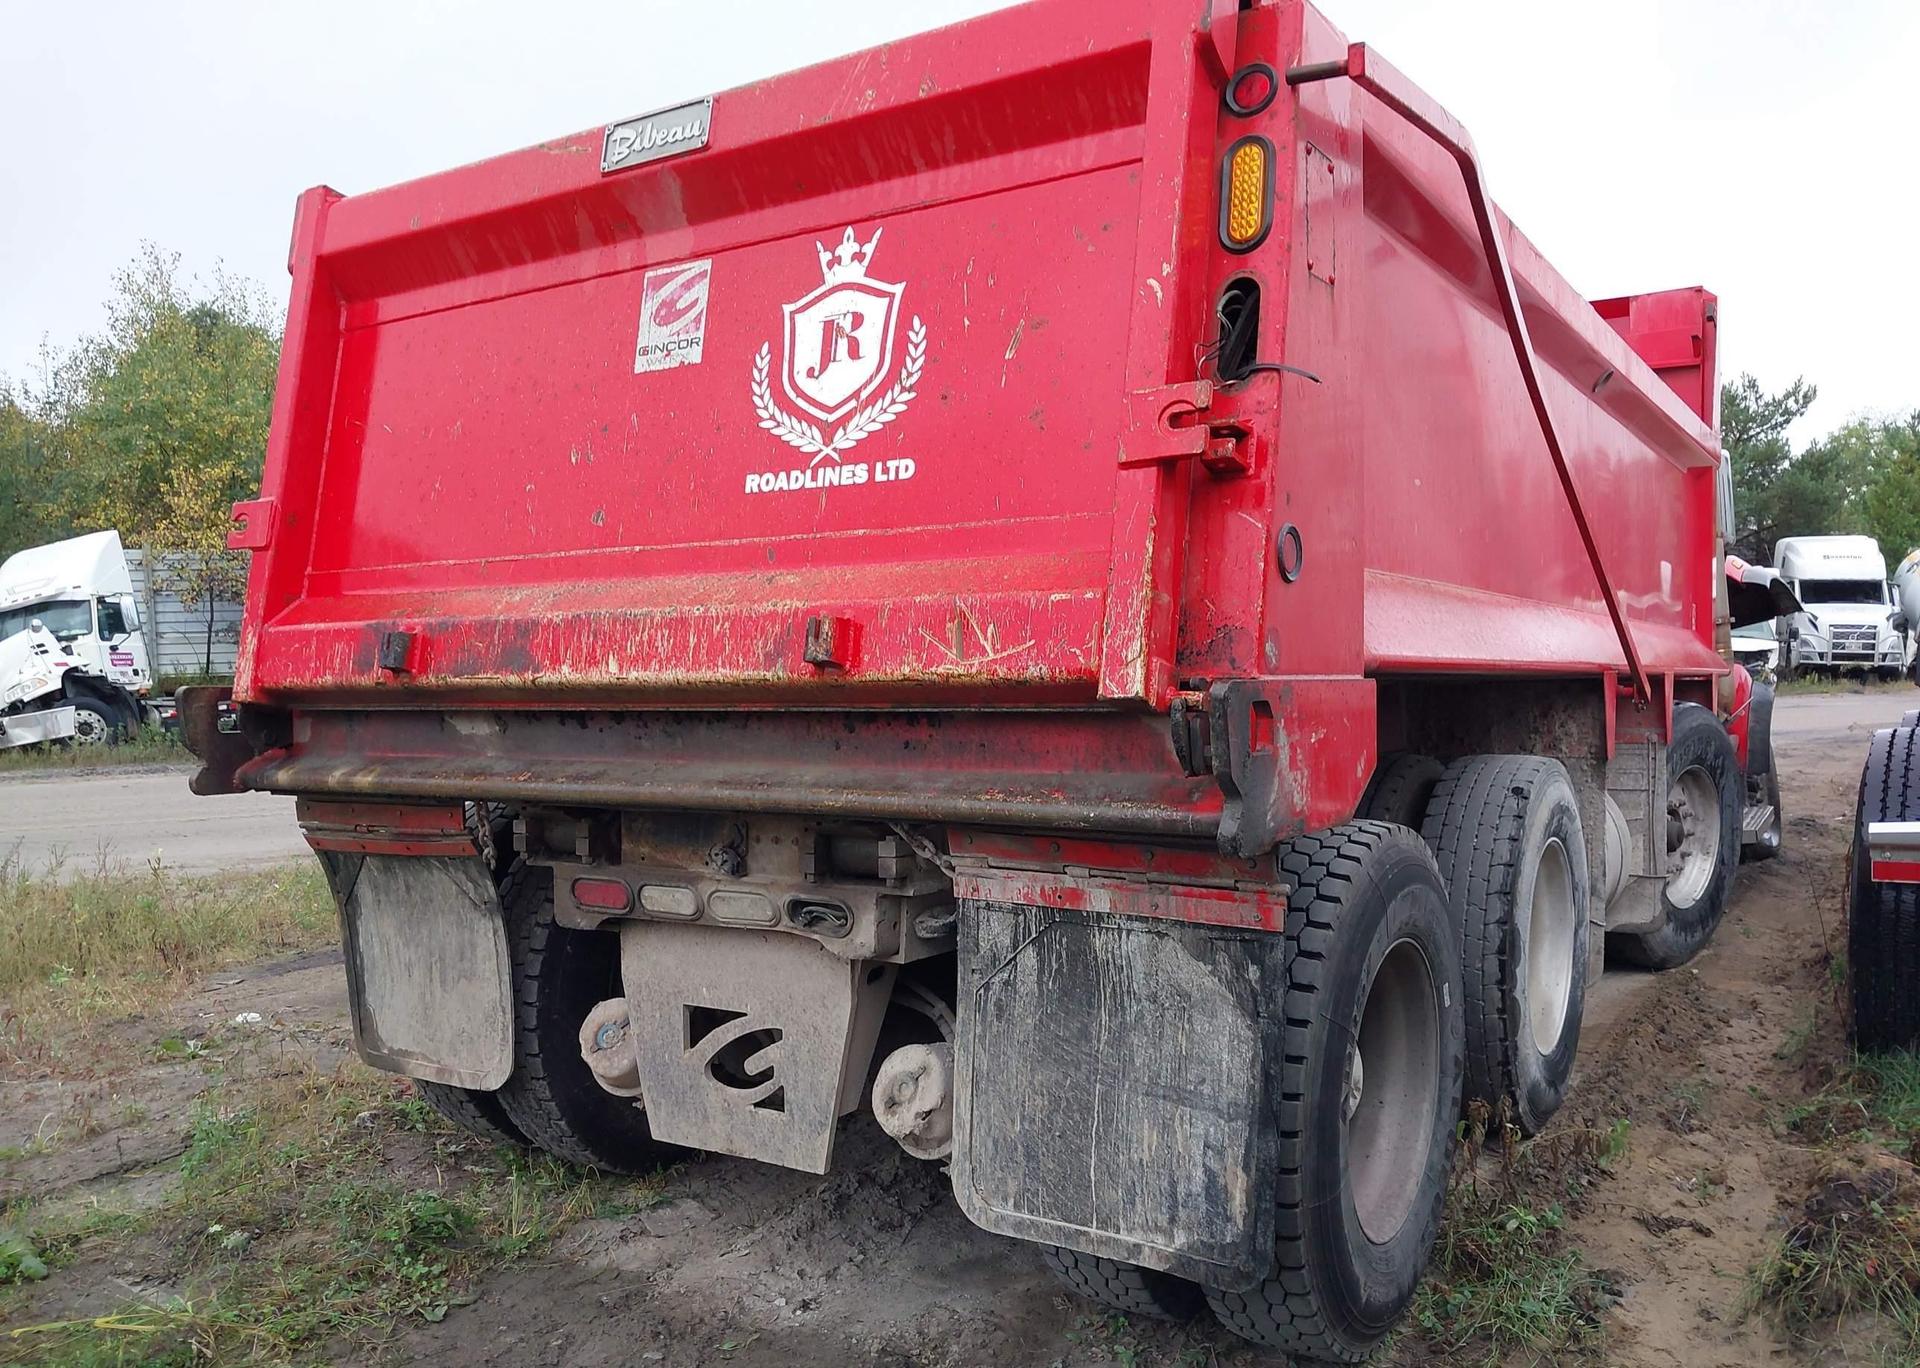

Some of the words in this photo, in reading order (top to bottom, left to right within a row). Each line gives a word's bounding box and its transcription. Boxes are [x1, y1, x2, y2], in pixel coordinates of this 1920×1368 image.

[611, 119, 704, 164] Bibeau
[638, 337, 701, 357] GINCOR
[745, 463, 869, 494] ROADLINES
[874, 458, 916, 483] LTD
